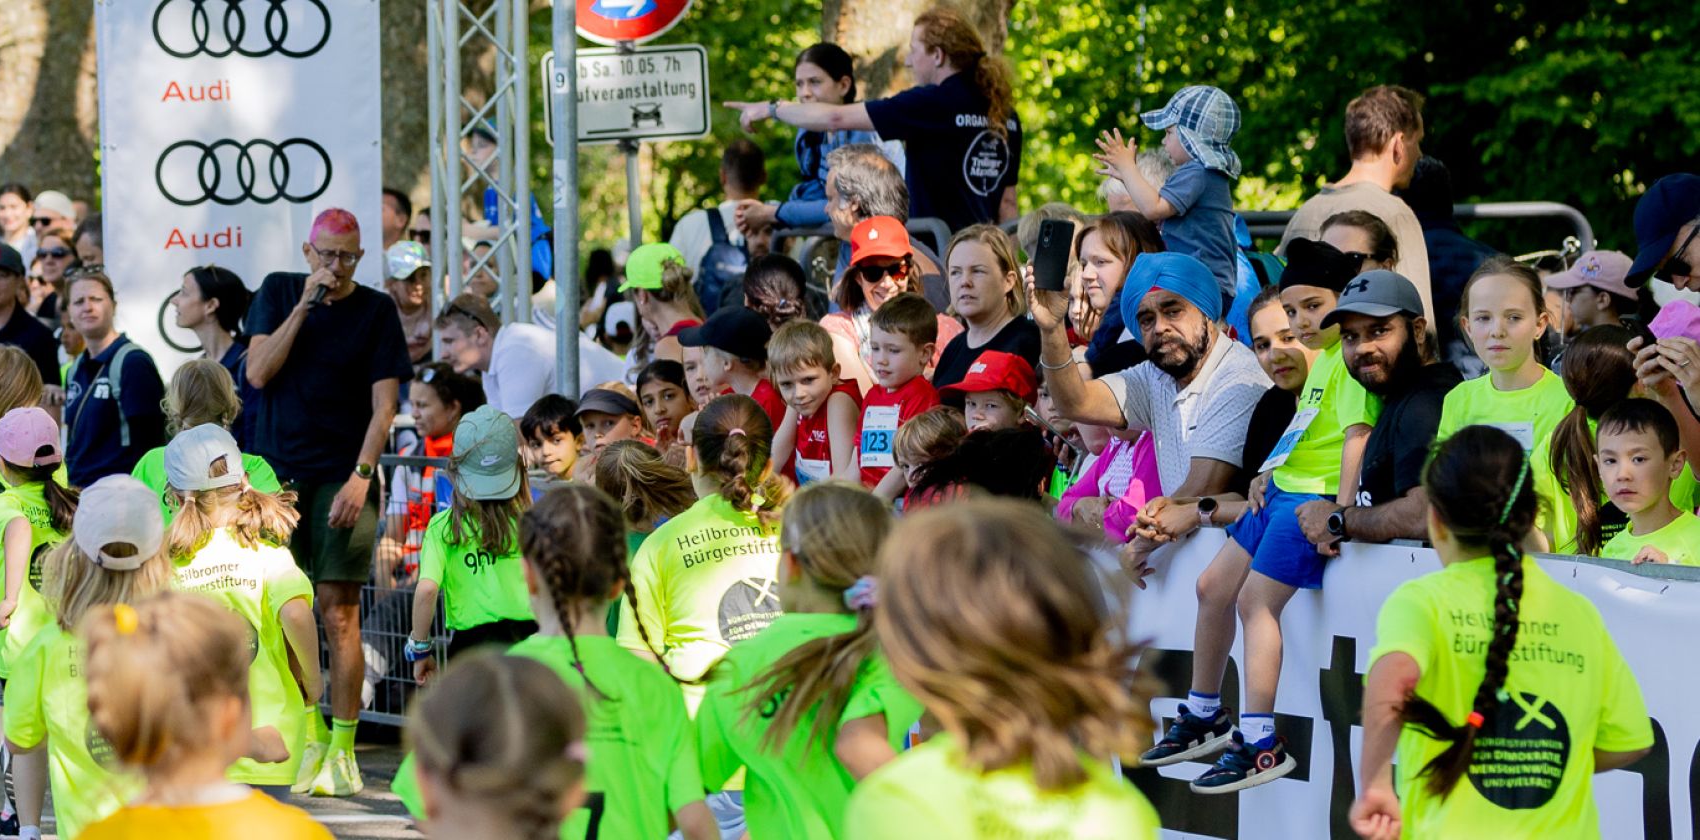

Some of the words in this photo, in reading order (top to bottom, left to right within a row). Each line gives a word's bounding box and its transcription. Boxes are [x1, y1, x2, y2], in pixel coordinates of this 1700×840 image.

[575, 65, 588, 79] b
[593, 61, 616, 78] Sa.
[620, 57, 661, 75] 10.05.
[665, 56, 681, 73] 7h
[161, 80, 231, 102] Audi
[576, 81, 696, 104] ufveranstaltung
[164, 224, 242, 249] Audi
[863, 432, 888, 452] 123
[676, 526, 778, 551] Heilbronnr
